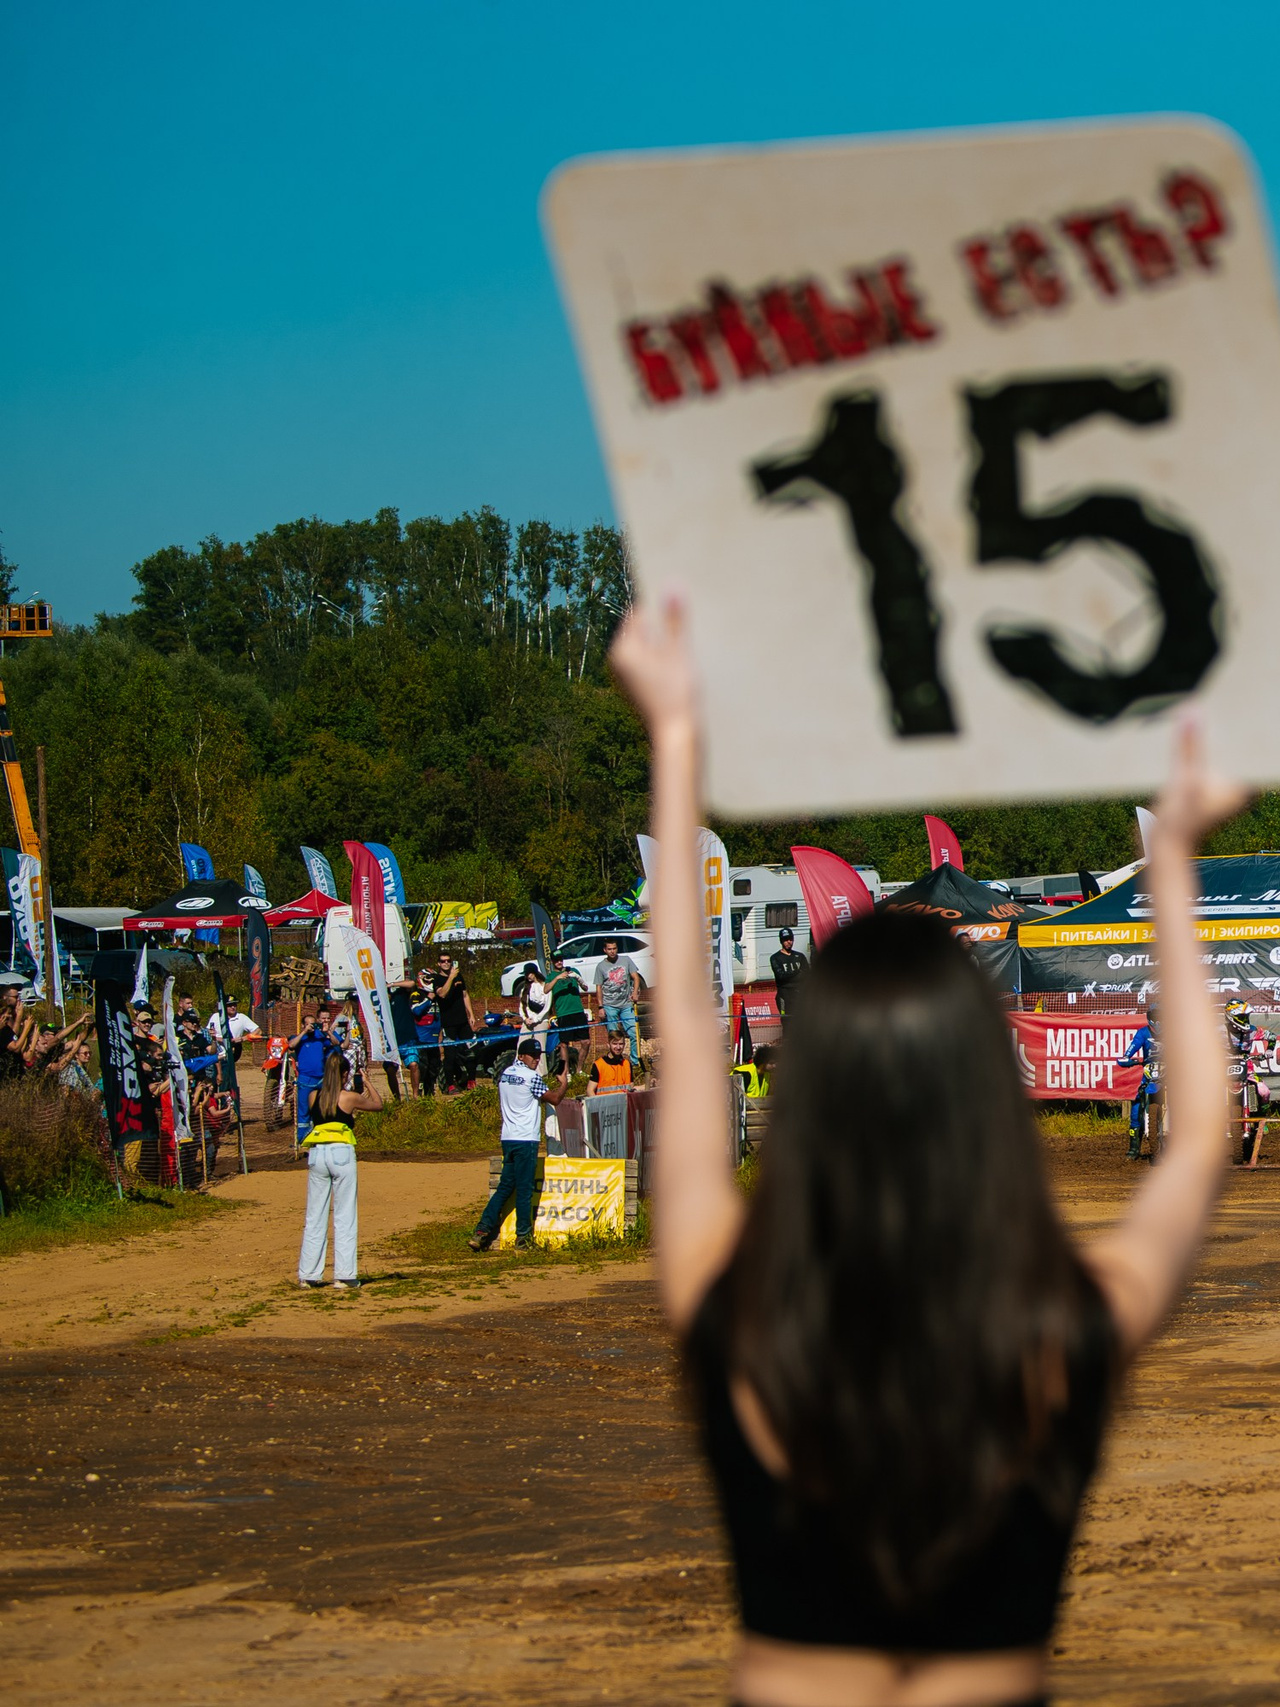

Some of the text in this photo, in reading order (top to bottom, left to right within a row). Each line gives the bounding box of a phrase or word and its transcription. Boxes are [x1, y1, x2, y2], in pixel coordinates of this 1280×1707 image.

[957, 167, 1234, 327] ЕСТЬ?
[748, 366, 1224, 740] 15
[988, 903, 1025, 919] KAYO
[1061, 929, 1130, 942] ПИТБАЙКИ
[1138, 993, 1145, 1003] 2
[1046, 1060, 1117, 1089] СПОРТ
[534, 1178, 609, 1196] ОКИНЬ
[533, 1205, 607, 1222] РАССУ
